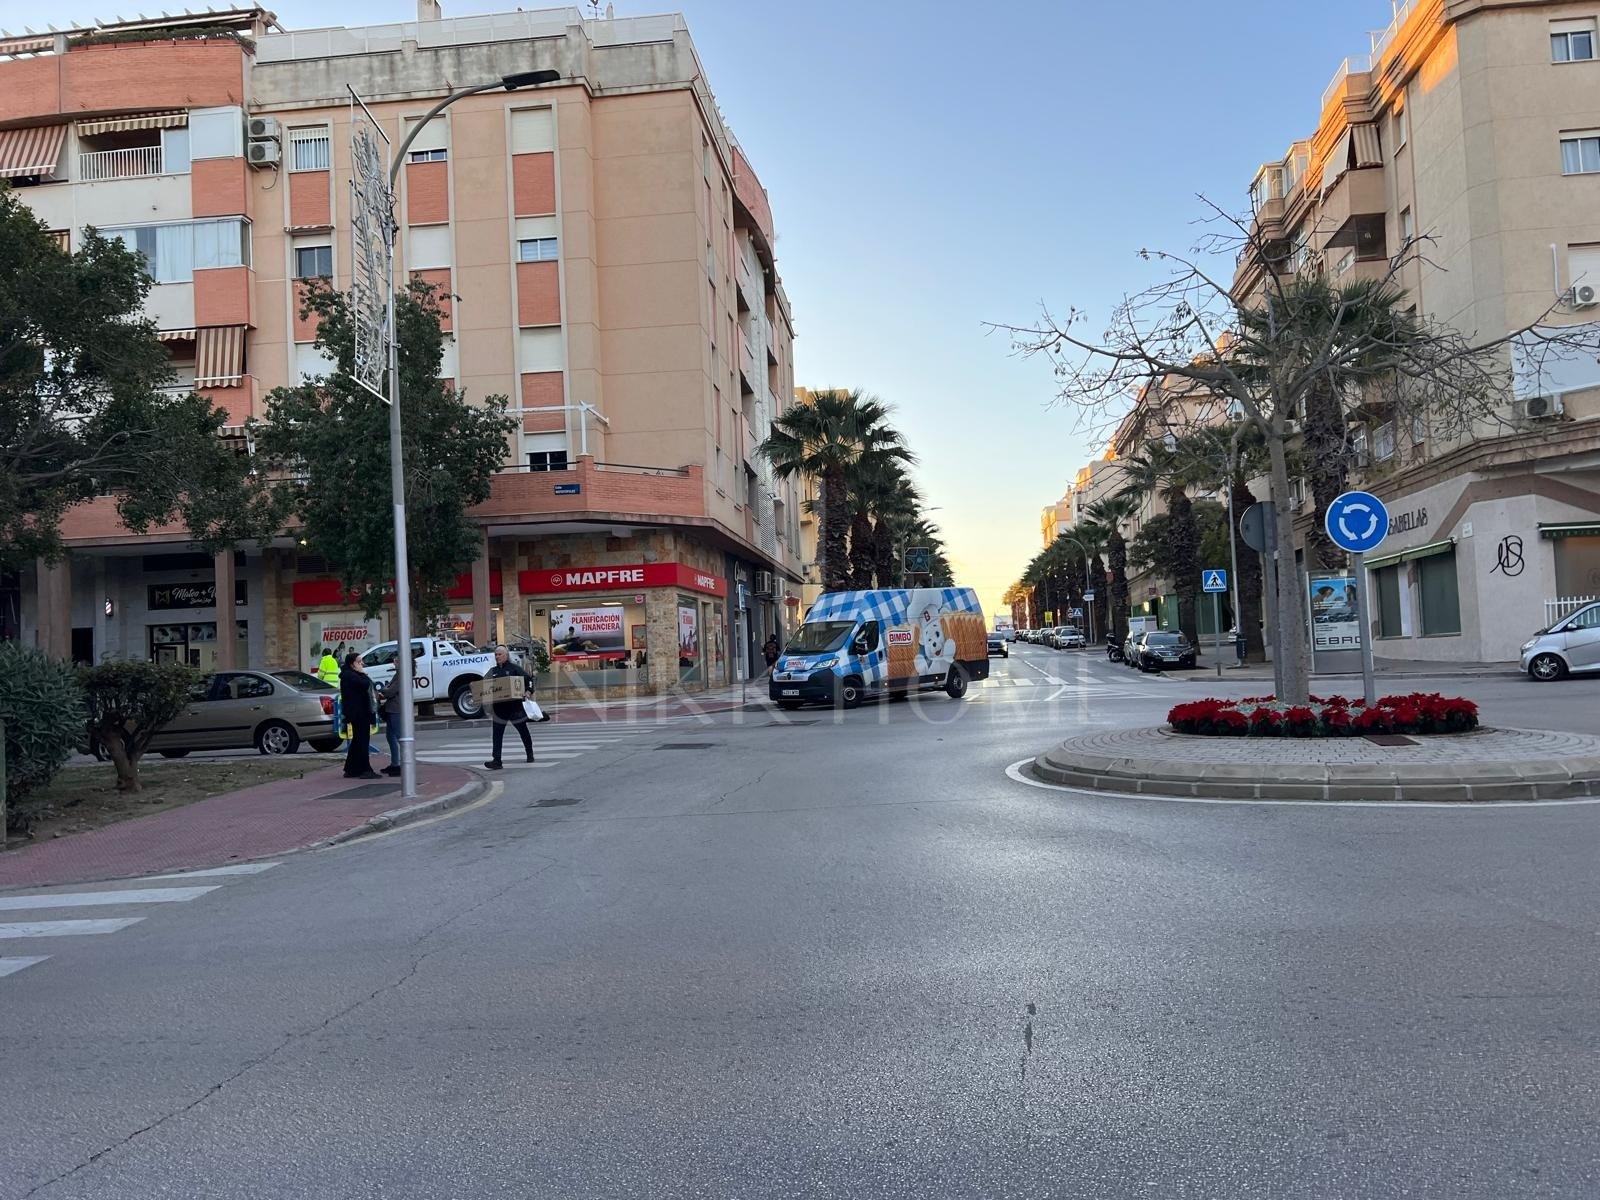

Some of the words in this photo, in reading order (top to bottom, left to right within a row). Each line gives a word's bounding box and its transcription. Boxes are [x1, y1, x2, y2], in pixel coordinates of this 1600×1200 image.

[566, 569, 644, 586] MAPFRE
[697, 573, 715, 590] MAPFRE
[172, 587, 200, 601] Mateo
[571, 613, 620, 624] PLANIFICACIÓN
[581, 622, 620, 632] FINANCIERA
[322, 630, 368, 642] NEGOCIO?
[889, 632, 912, 642] BIMBO
[442, 655, 489, 667] ASISTENCIA
